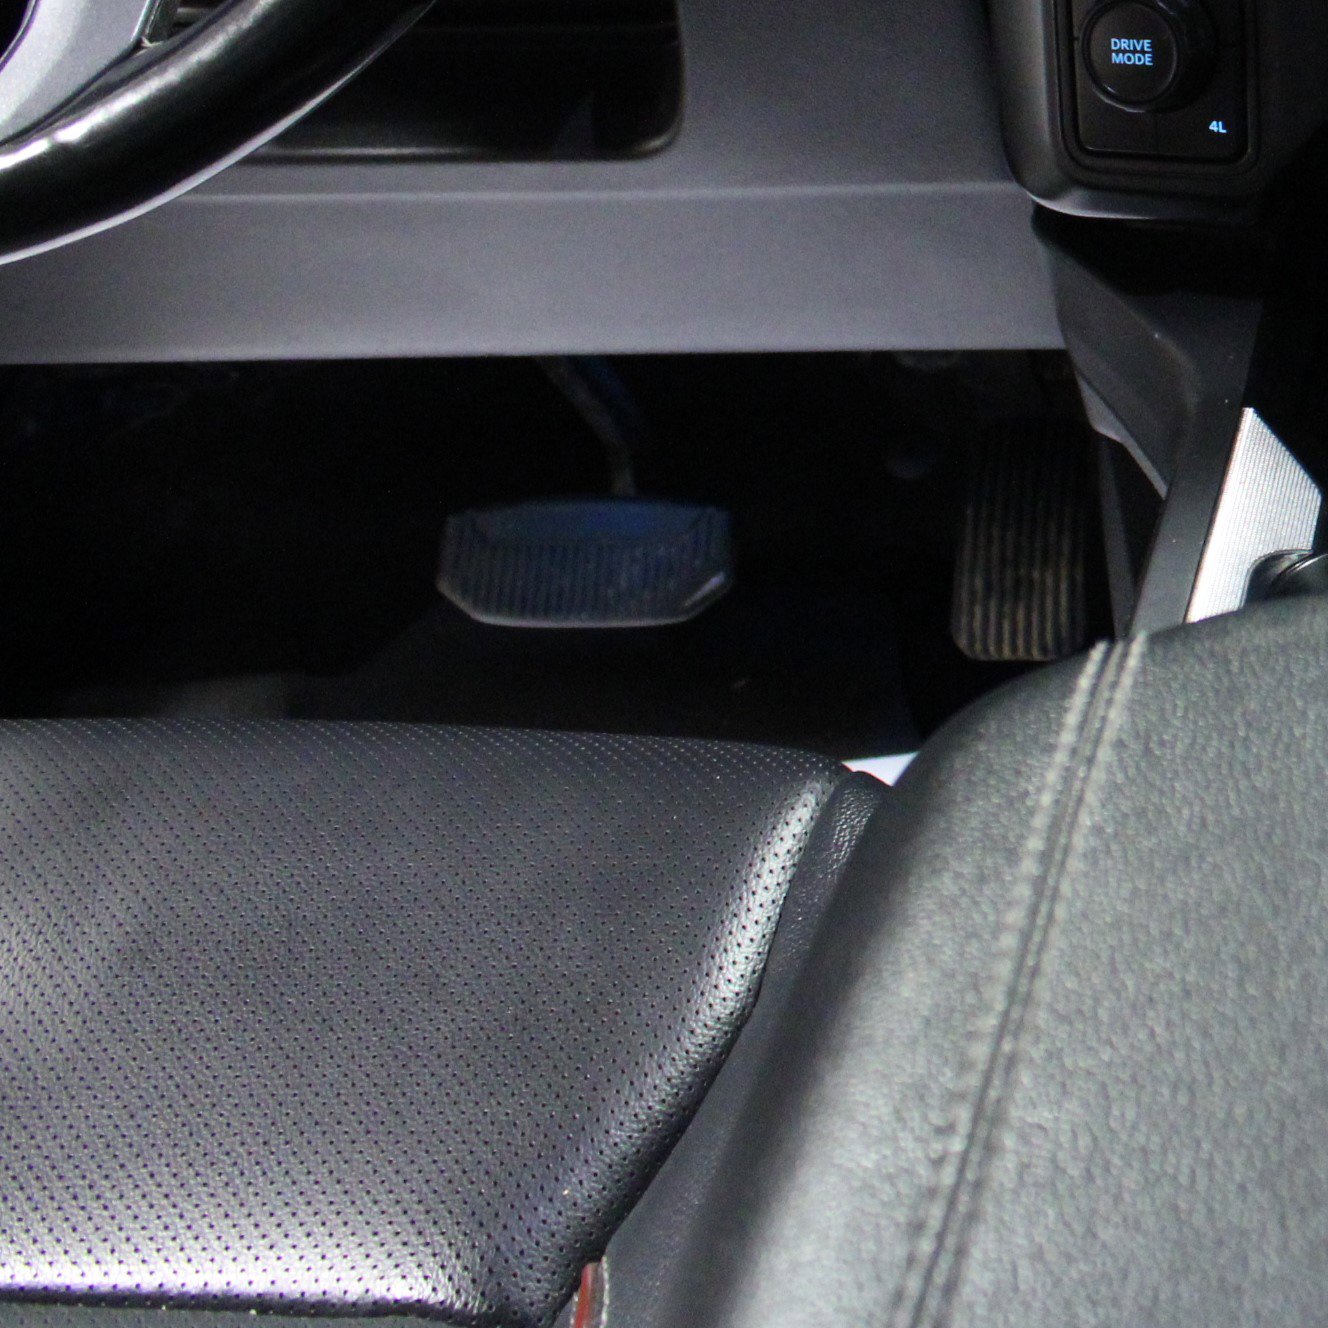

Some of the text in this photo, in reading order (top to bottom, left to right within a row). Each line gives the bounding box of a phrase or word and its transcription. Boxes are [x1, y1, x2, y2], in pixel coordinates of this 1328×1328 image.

[1110, 37, 1153, 52] DRIVE
[1111, 51, 1154, 66] MODE
[1208, 119, 1228, 134] 4L
